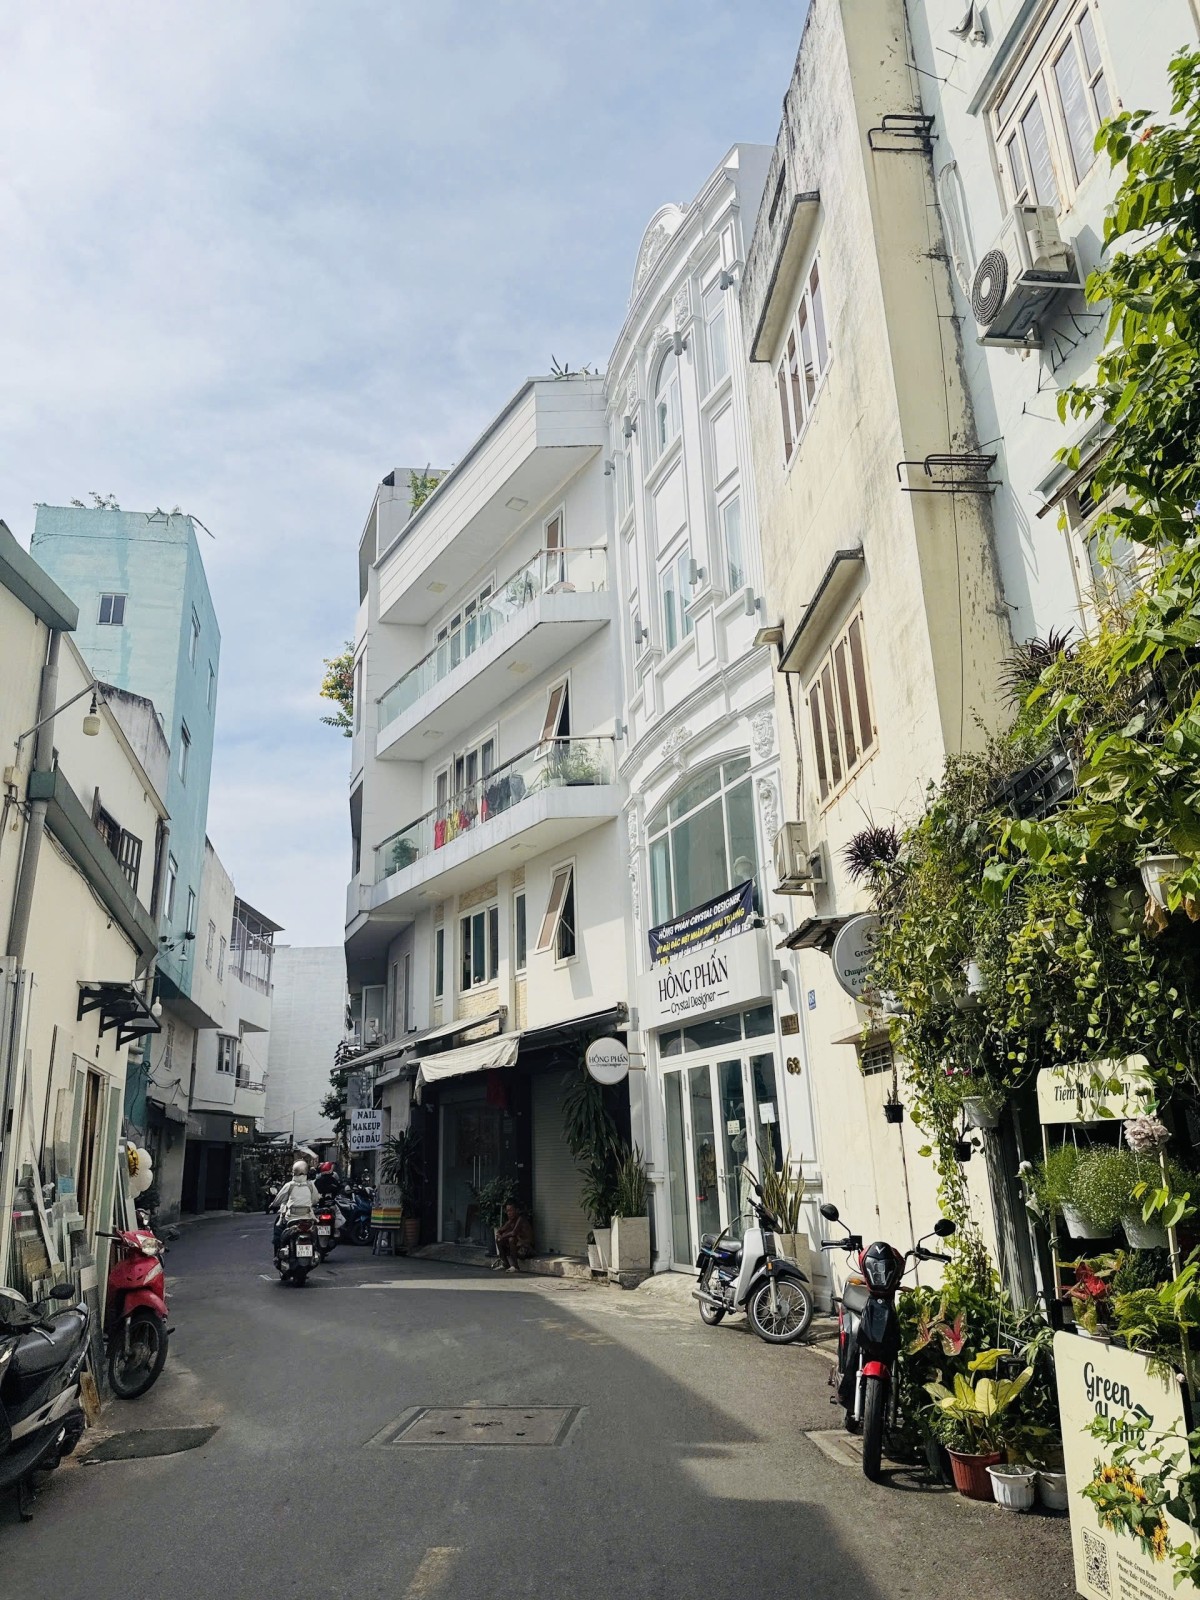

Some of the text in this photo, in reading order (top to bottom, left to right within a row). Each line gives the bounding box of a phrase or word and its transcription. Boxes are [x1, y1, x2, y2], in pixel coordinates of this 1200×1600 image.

[690, 908, 713, 926] CRYSTAL
[713, 893, 741, 916] DESIGNER
[658, 948, 729, 1002] HỒNG PHẤN
[671, 991, 716, 1015] Crystal Designer
[787, 1057, 801, 1075] 68
[1054, 1085, 1077, 1105] Tiệm
[357, 1111, 377, 1119] NAIL
[352, 1122, 381, 1131] MAKEUP
[1083, 1361, 1133, 1410] Green
